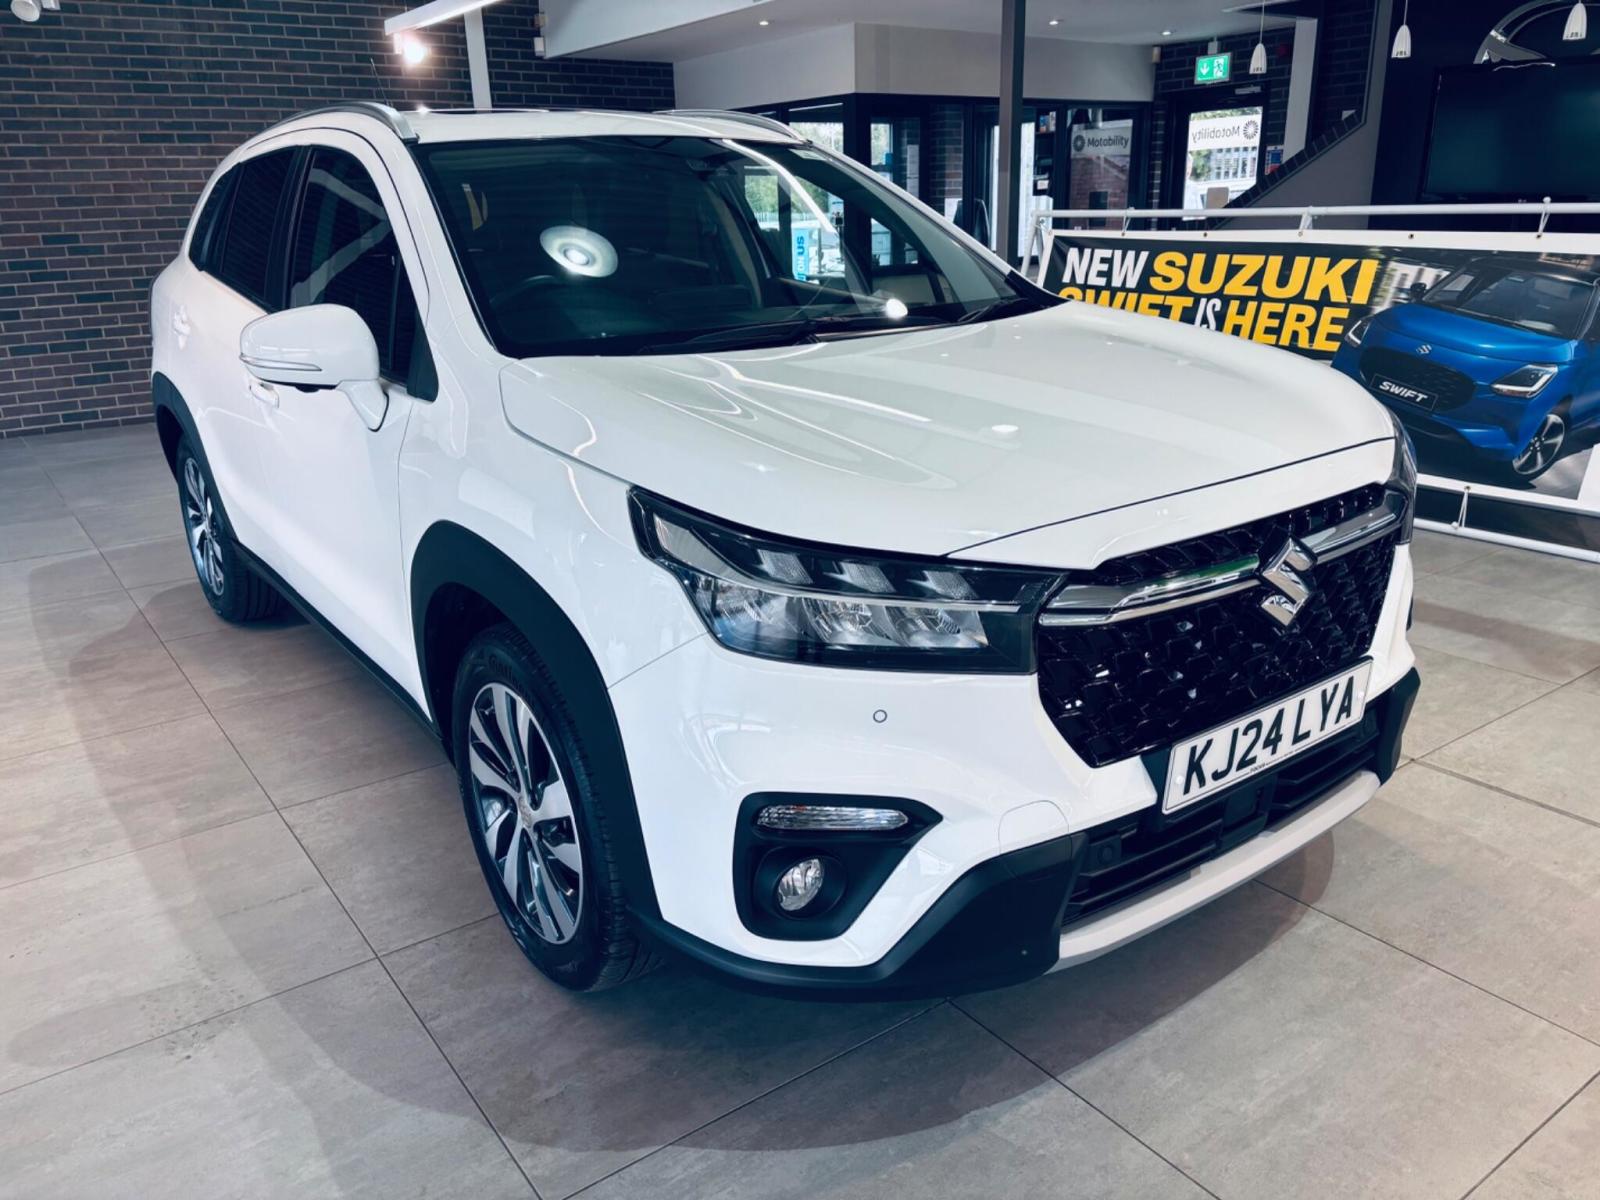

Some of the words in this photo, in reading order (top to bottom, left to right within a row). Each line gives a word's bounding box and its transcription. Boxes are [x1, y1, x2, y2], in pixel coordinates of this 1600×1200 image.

[1087, 134, 1130, 149] Motability
[1062, 247, 1149, 289] NEW
[1149, 250, 1380, 305] SUZUKI
[1223, 299, 1350, 353] HERE
[1379, 381, 1429, 402] SWIFT
[1183, 708, 1286, 796] KJ24
[1291, 675, 1355, 746] LYA
